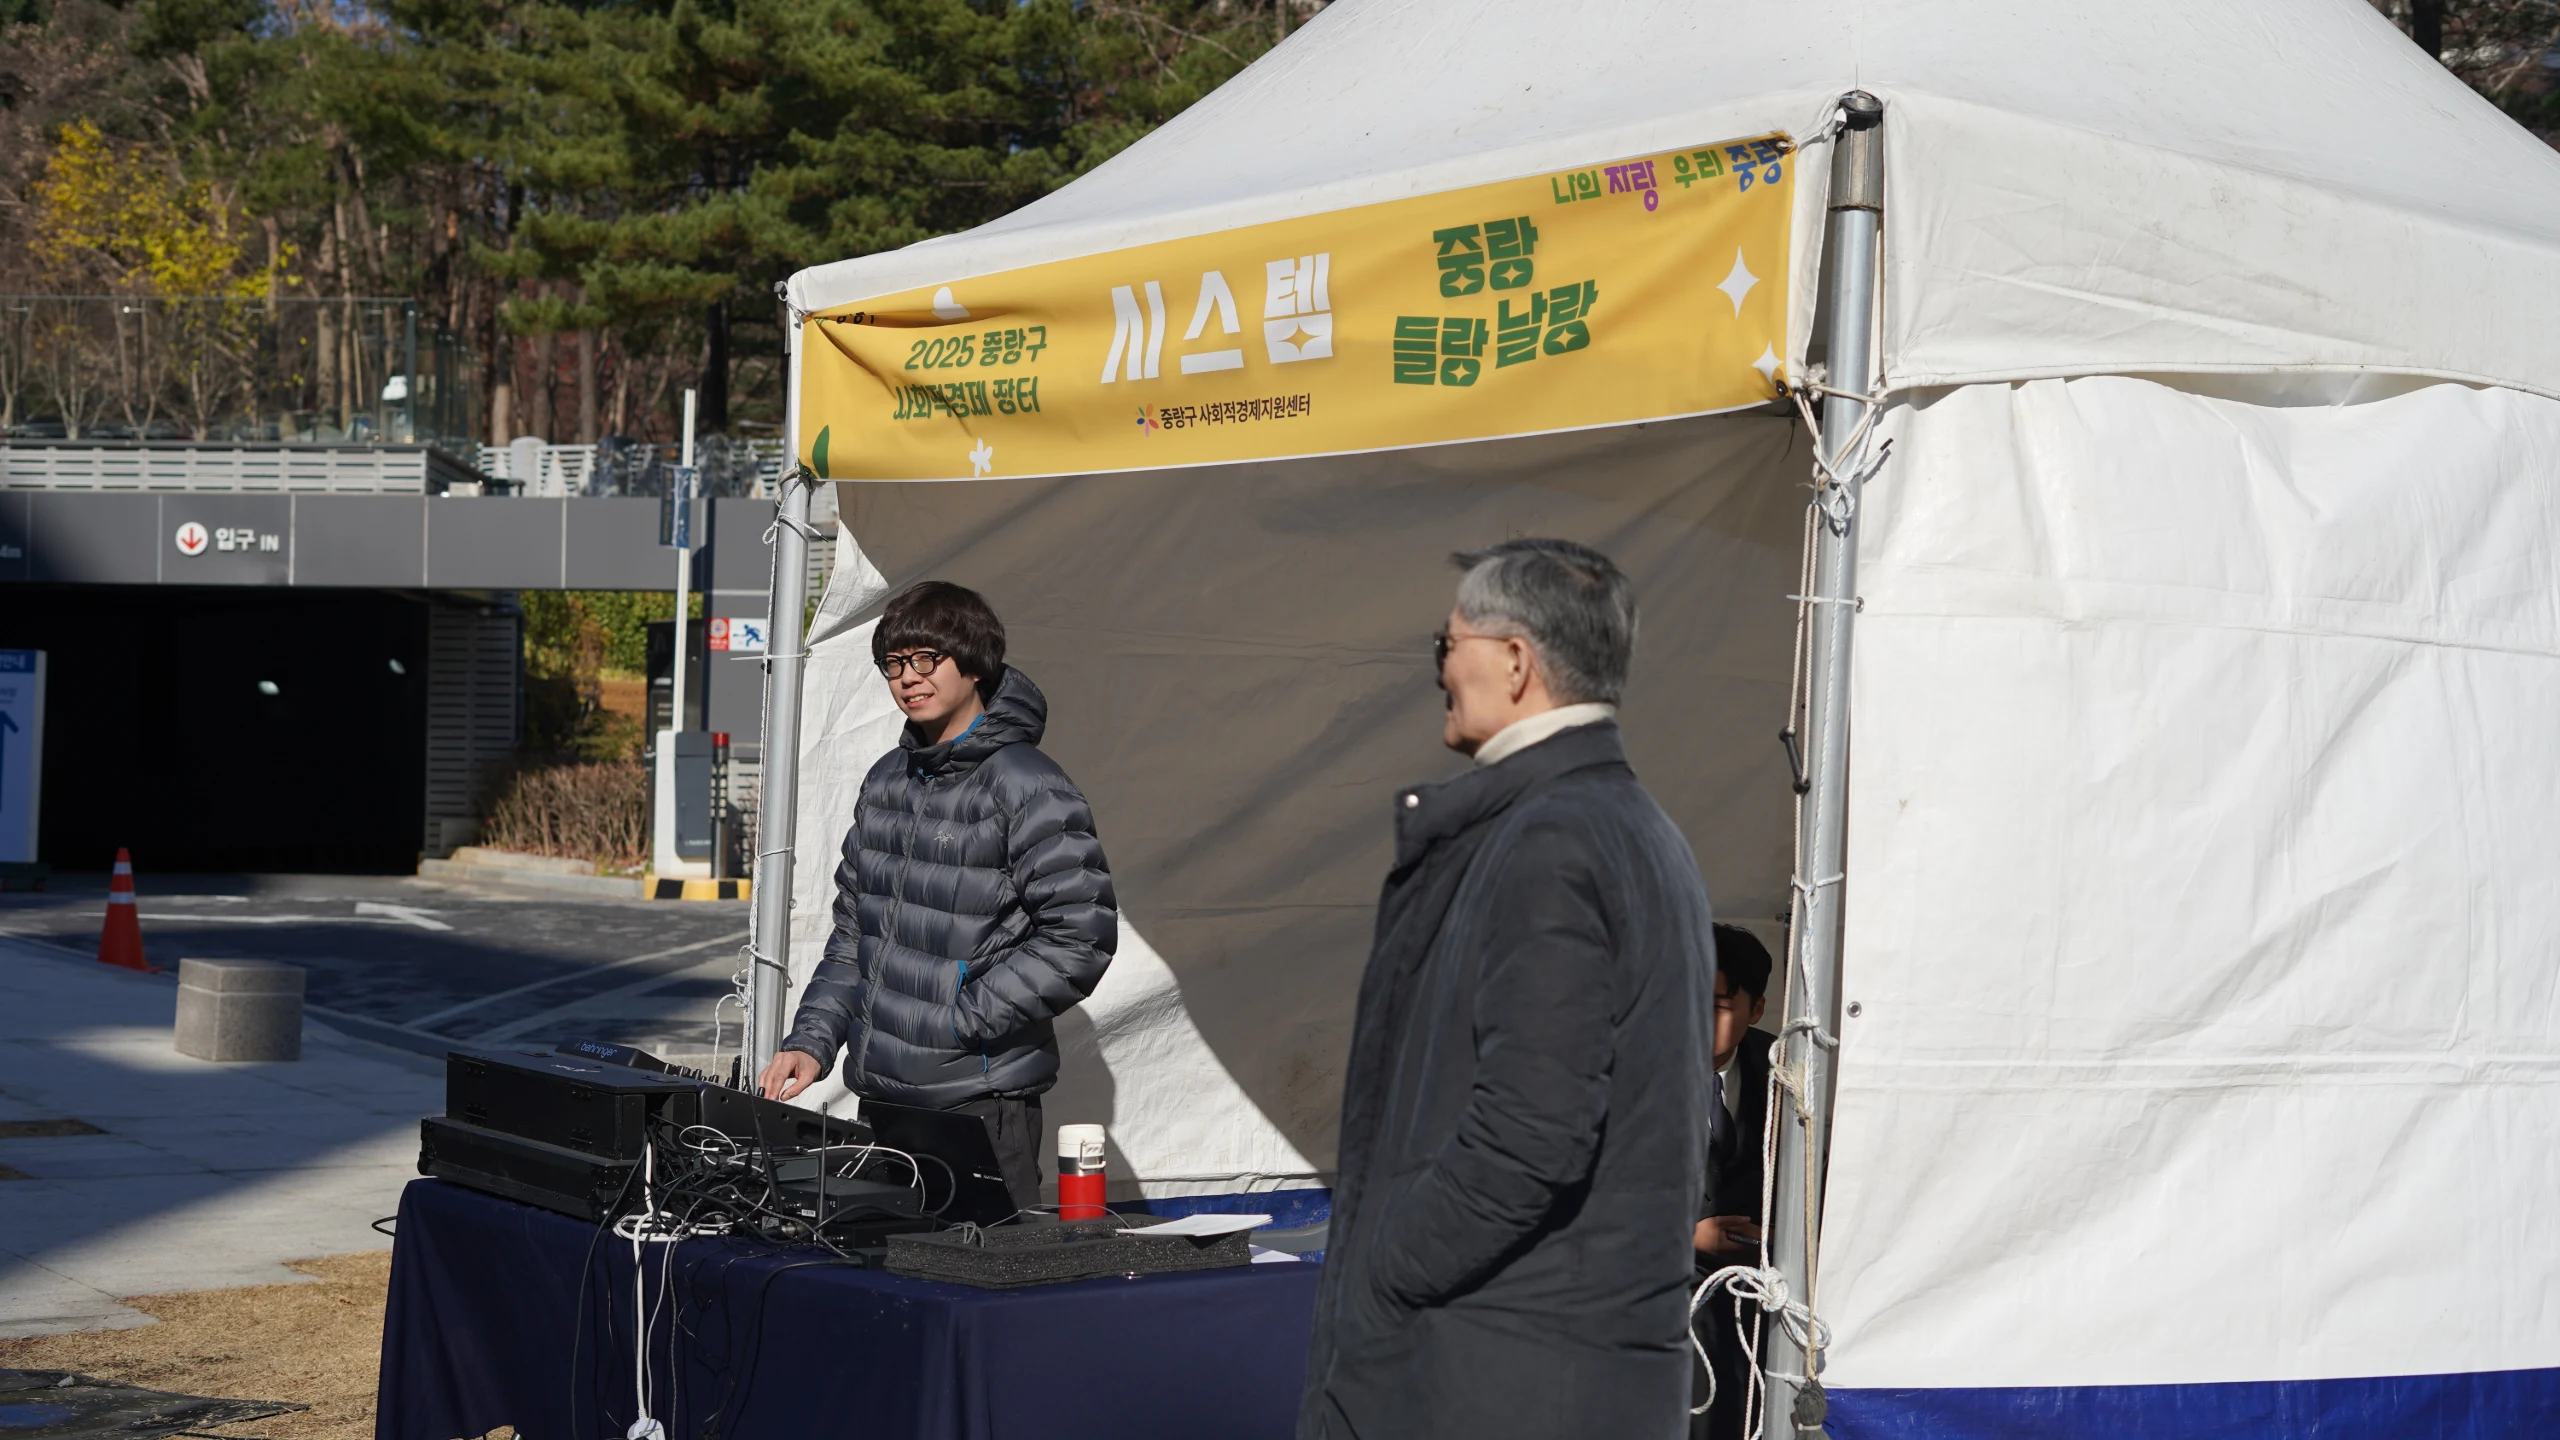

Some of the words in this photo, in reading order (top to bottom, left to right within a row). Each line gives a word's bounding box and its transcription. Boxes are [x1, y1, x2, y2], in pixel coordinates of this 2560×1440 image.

[1551, 170, 1602, 204] 나의
[1604, 159, 1659, 212] 자랑
[1673, 149, 1725, 189] 우리
[1724, 138, 1785, 193] 중랑
[1432, 215, 1539, 298] 중랑
[1100, 252, 1334, 384] 시스템
[904, 334, 977, 371] 2025
[978, 325, 1048, 367] 중랑구
[893, 379, 993, 420] 사회적경제
[992, 375, 1041, 415] 장터
[1159, 406, 1198, 430] 중랑구
[1199, 392, 1311, 426] 사회적경제지원센터
[215, 527, 256, 551] 입구
[260, 534, 279, 552] IN
[580, 1041, 618, 1059] behringer
